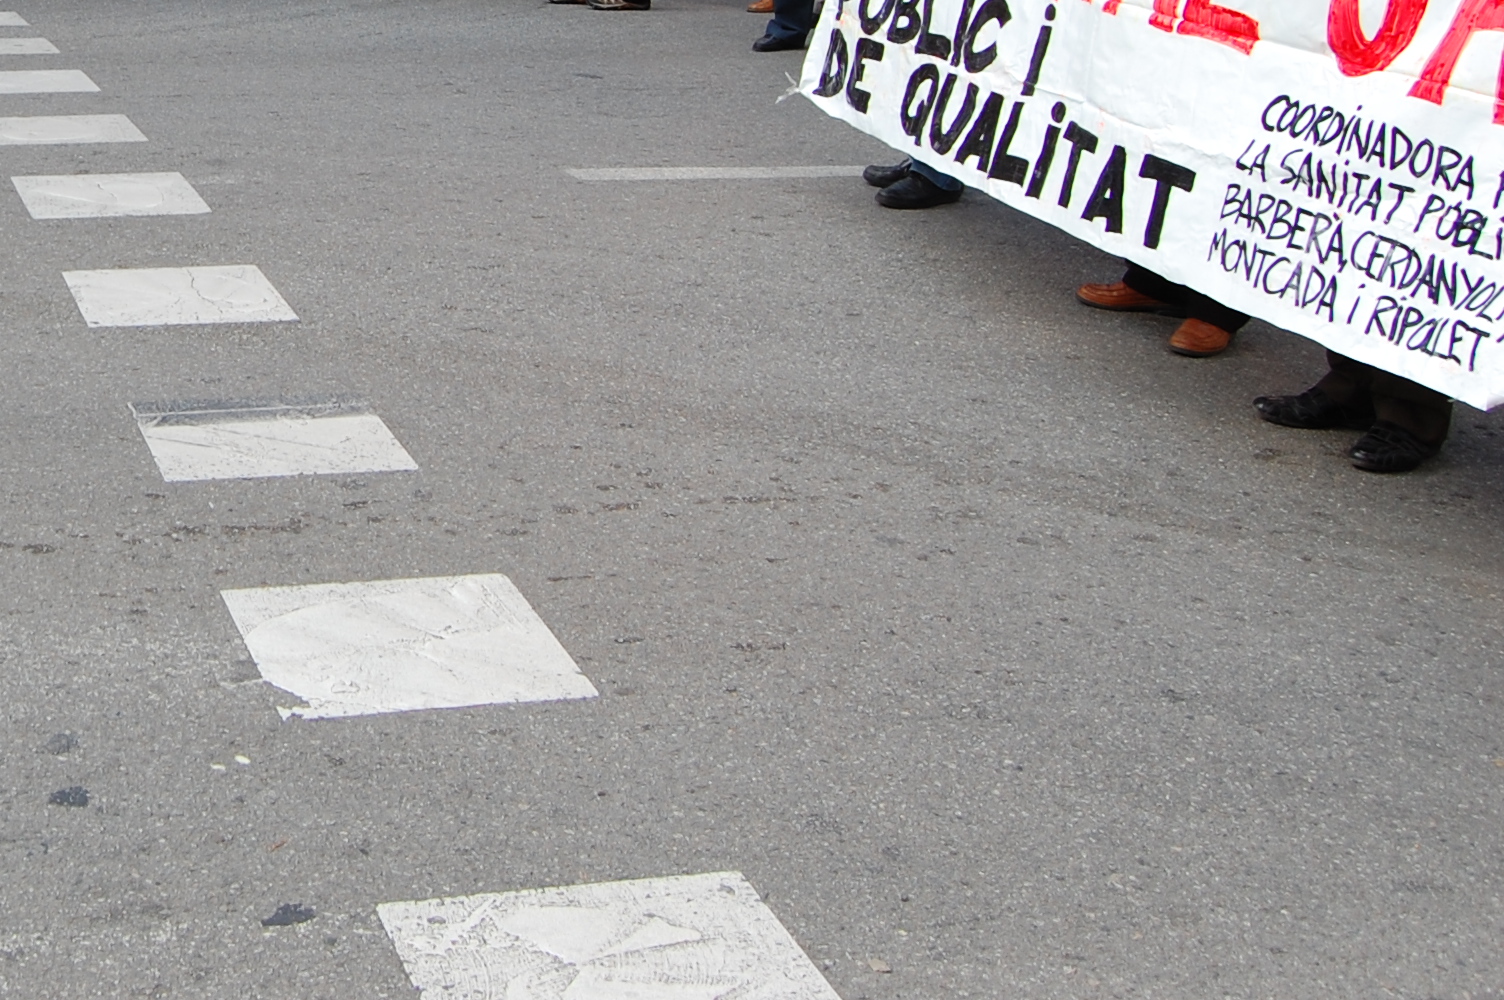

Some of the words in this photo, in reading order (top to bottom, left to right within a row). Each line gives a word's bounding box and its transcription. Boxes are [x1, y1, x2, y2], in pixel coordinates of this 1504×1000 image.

[811, 27, 886, 115] DE
[1235, 139, 1271, 183] LA
[1207, 228, 1338, 324] MONTCADA
